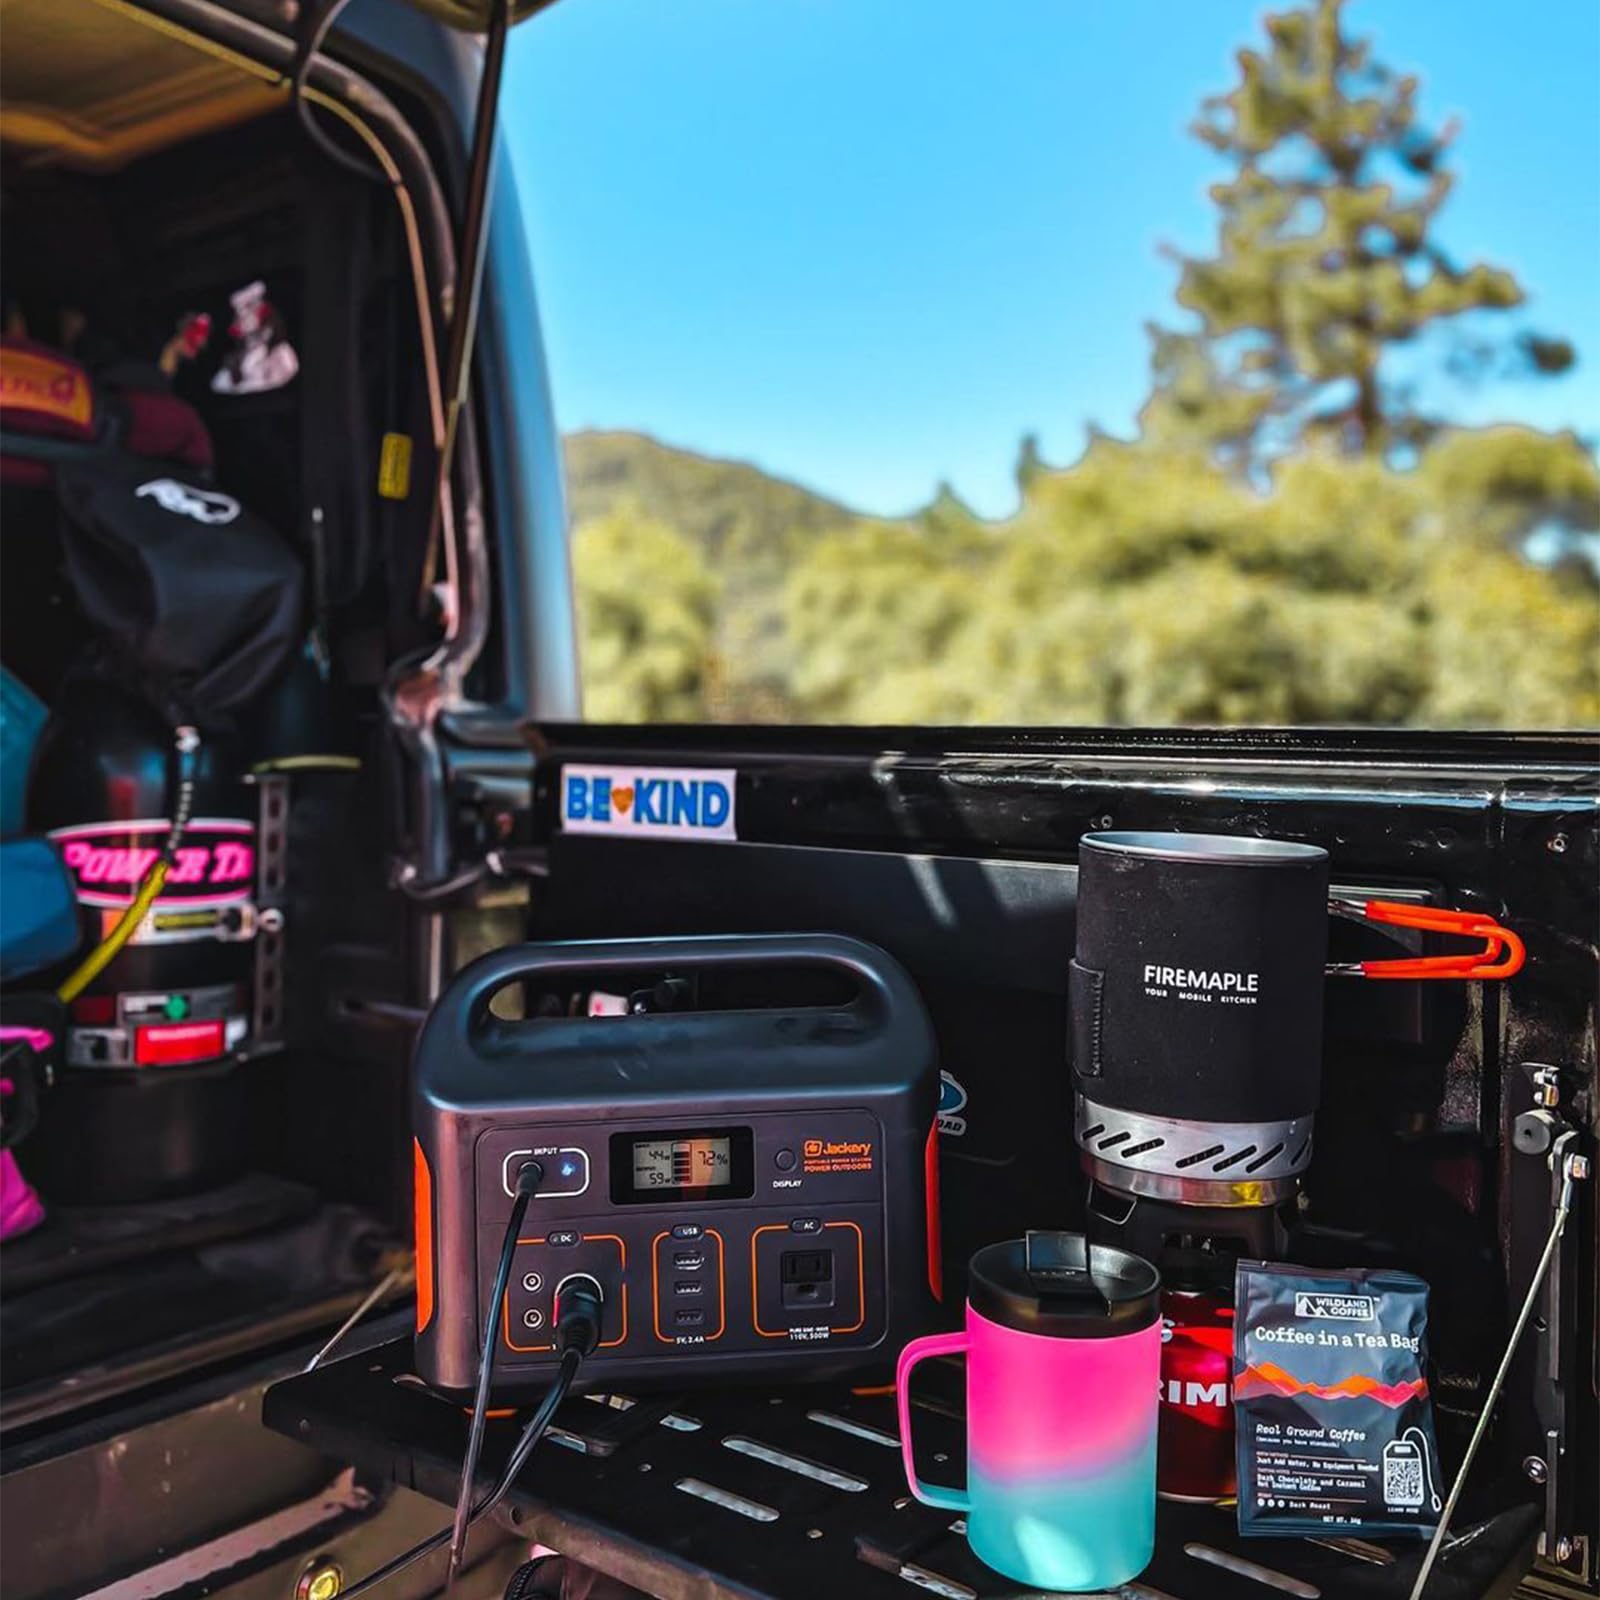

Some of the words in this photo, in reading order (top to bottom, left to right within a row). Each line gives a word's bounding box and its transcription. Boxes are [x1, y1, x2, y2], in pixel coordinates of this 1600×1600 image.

[568, 777, 611, 822] BE
[633, 778, 730, 827] KIND
[64, 841, 211, 884] POWR
[1144, 964, 1259, 992] FIREMAPLE
[1145, 987, 1168, 998] YOUR
[1178, 992, 1212, 1003] MOBILE
[1220, 996, 1257, 1005] KITCHEN
[534, 1147, 558, 1156] INPUT
[823, 1142, 872, 1156] Jackery
[698, 1150, 728, 1166] 72%
[832, 1163, 872, 1171] OUTDOORS
[772, 1180, 803, 1189] DISPLAY
[682, 1227, 698, 1235] USB
[803, 1221, 815, 1230] AC
[560, 1233, 572, 1242] DC
[1315, 1297, 1367, 1309] WILDLAND
[1330, 1307, 1369, 1317] COFFEE
[1255, 1326, 1315, 1345] Coffee
[1318, 1330, 1339, 1347] in
[1342, 1333, 1353, 1347] a
[1354, 1332, 1388, 1349] Tea
[1391, 1333, 1420, 1353] Bag
[1256, 1423, 1281, 1436] Real
[1286, 1425, 1325, 1438] Ground
[1329, 1428, 1366, 1442] Coffee
[1289, 1500, 1307, 1508] Dark
